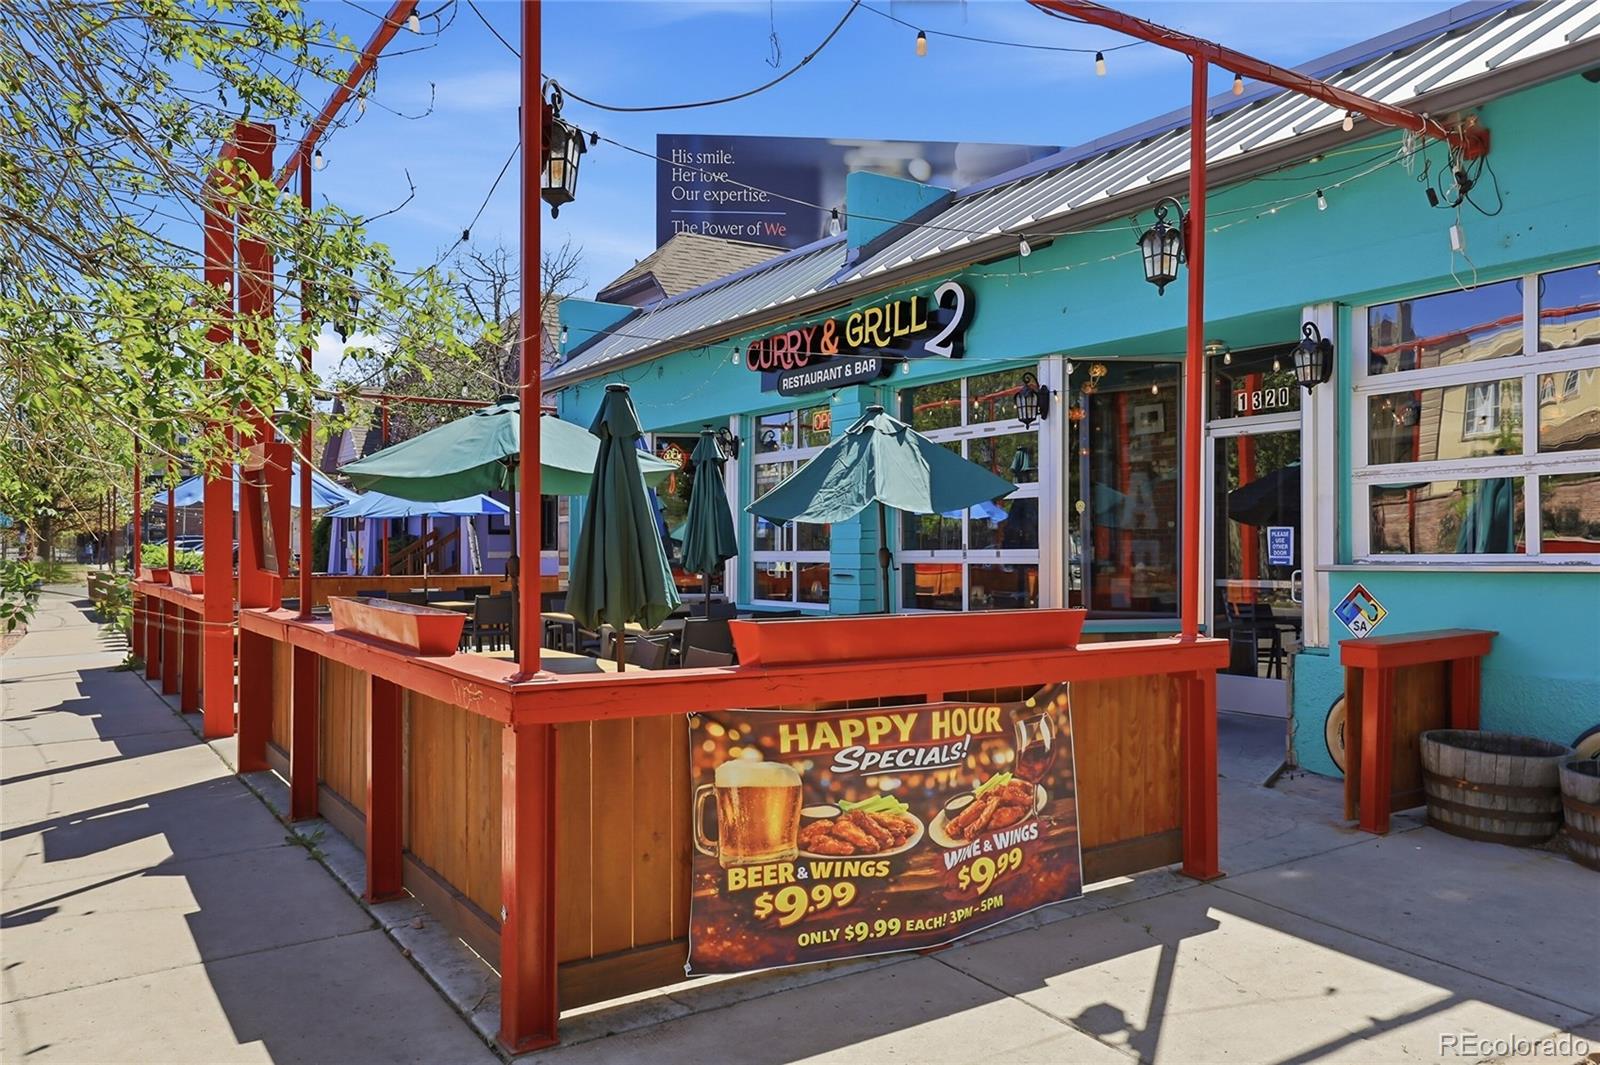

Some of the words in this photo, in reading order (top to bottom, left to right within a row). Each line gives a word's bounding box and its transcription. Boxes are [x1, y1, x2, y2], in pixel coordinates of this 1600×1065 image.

[672, 149, 693, 164] His
[696, 150, 735, 164] smile.
[672, 168, 696, 182] Her
[672, 186, 699, 200] Our
[703, 187, 770, 204] expertise.
[671, 220, 698, 234] The
[702, 221, 743, 235] Power
[747, 221, 761, 235] of
[764, 222, 786, 236] We
[746, 326, 818, 371] CURRY
[821, 318, 839, 355] &
[846, 296, 927, 347] GRILL
[924, 282, 965, 358] 2
[782, 366, 842, 390] RESTAURANT
[844, 364, 852, 377] &
[854, 359, 876, 375] BAR
[1239, 387, 1288, 410] 1320
[1353, 620, 1367, 631] SA
[778, 713, 918, 754] HAPPY
[931, 706, 1003, 740] HOUR
[830, 734, 971, 773] SPECIALS!
[944, 838, 981, 870] WINE
[983, 840, 993, 852] &
[993, 822, 1039, 850] WINGS
[727, 862, 795, 891] BEER
[797, 866, 808, 879] &
[810, 860, 890, 879] WINGS
[958, 847, 1022, 895] $9.99
[754, 881, 856, 926] $9.99
[797, 928, 840, 947] ONLY
[845, 917, 901, 942] $9.99
[906, 913, 947, 932] EACH!
[949, 908, 973, 924] 3PM
[980, 895, 1004, 911] 5PM
